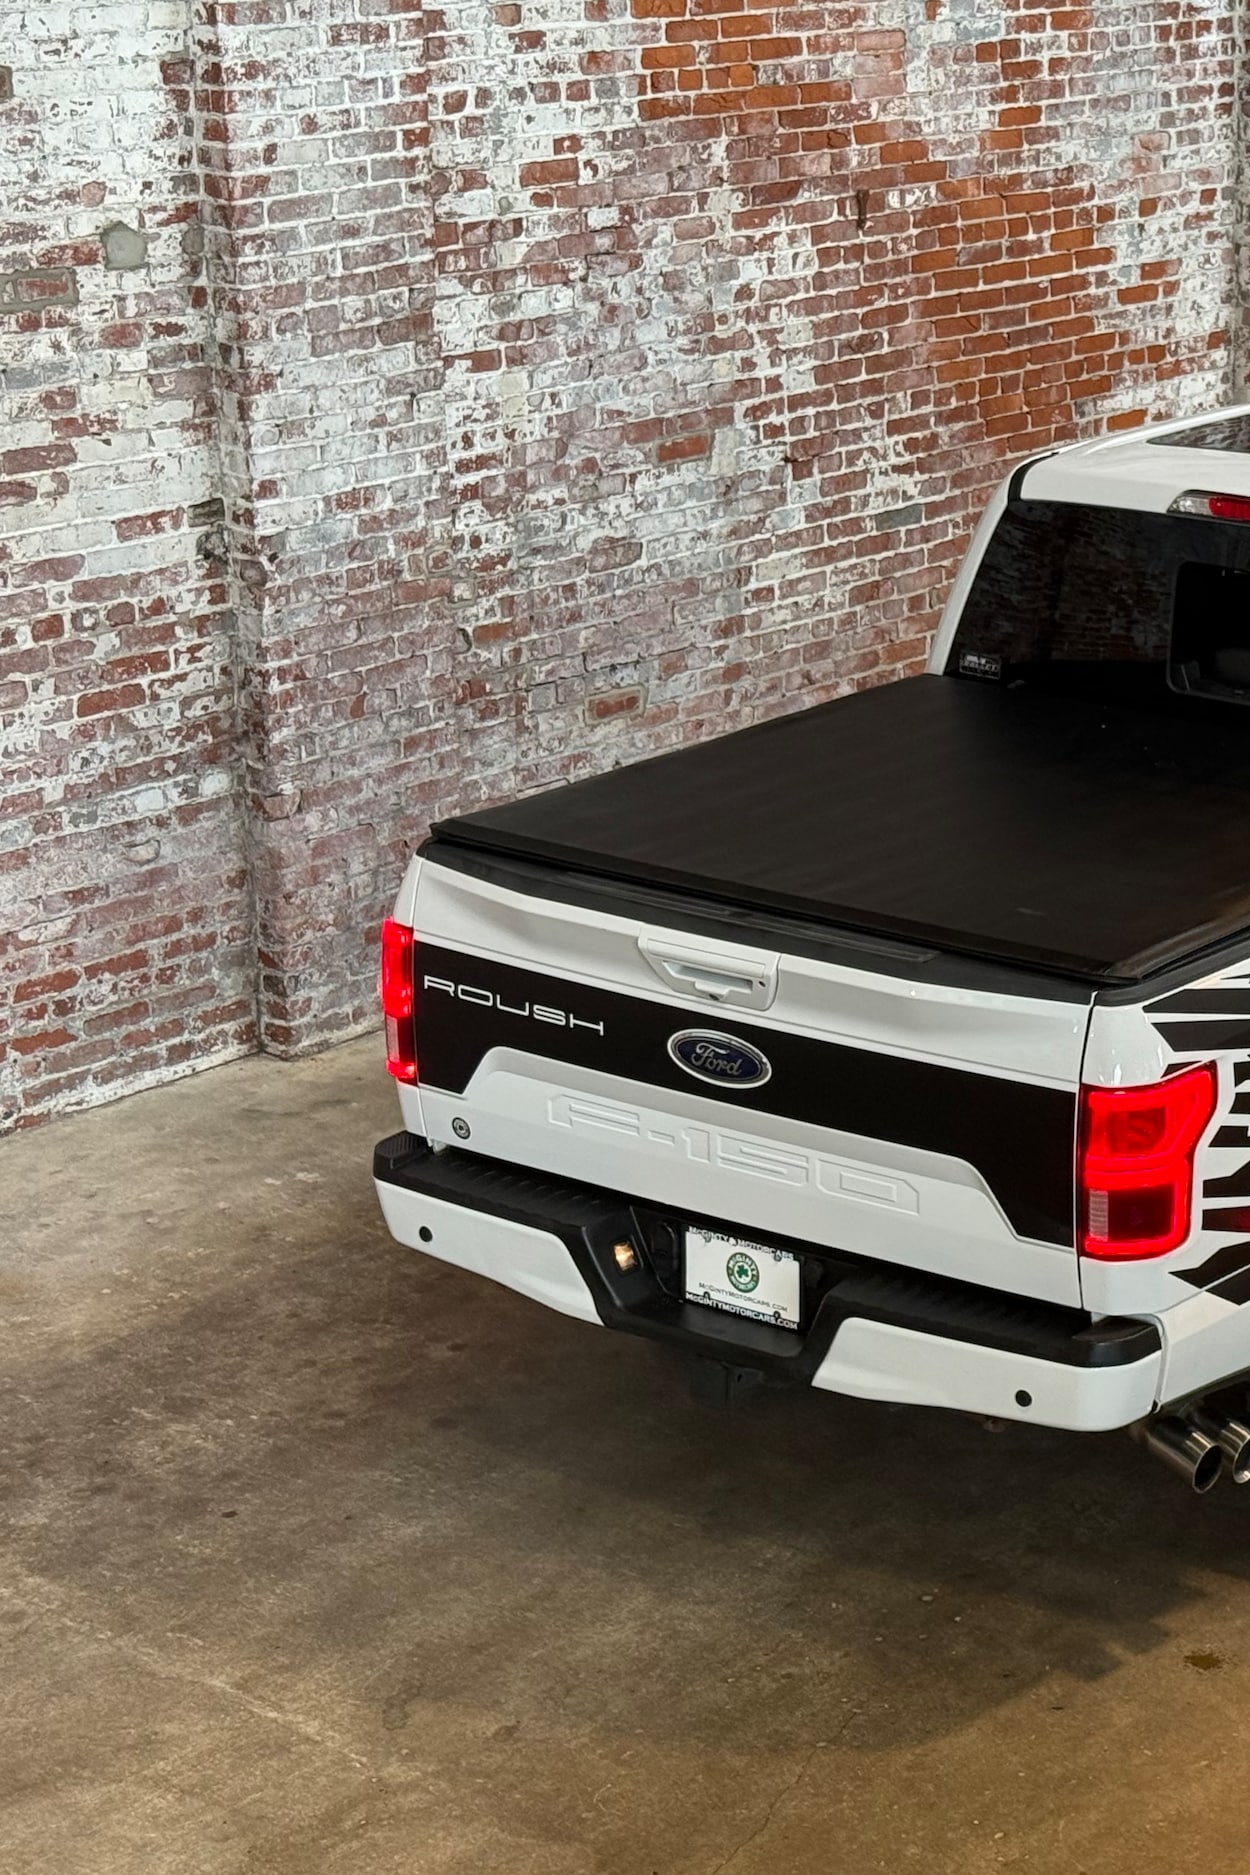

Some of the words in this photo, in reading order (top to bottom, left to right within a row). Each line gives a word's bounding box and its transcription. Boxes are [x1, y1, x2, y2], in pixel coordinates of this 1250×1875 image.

[423, 974, 605, 1036] ROUSH
[691, 1042, 742, 1076] Ford
[547, 1094, 920, 1217] F-150
